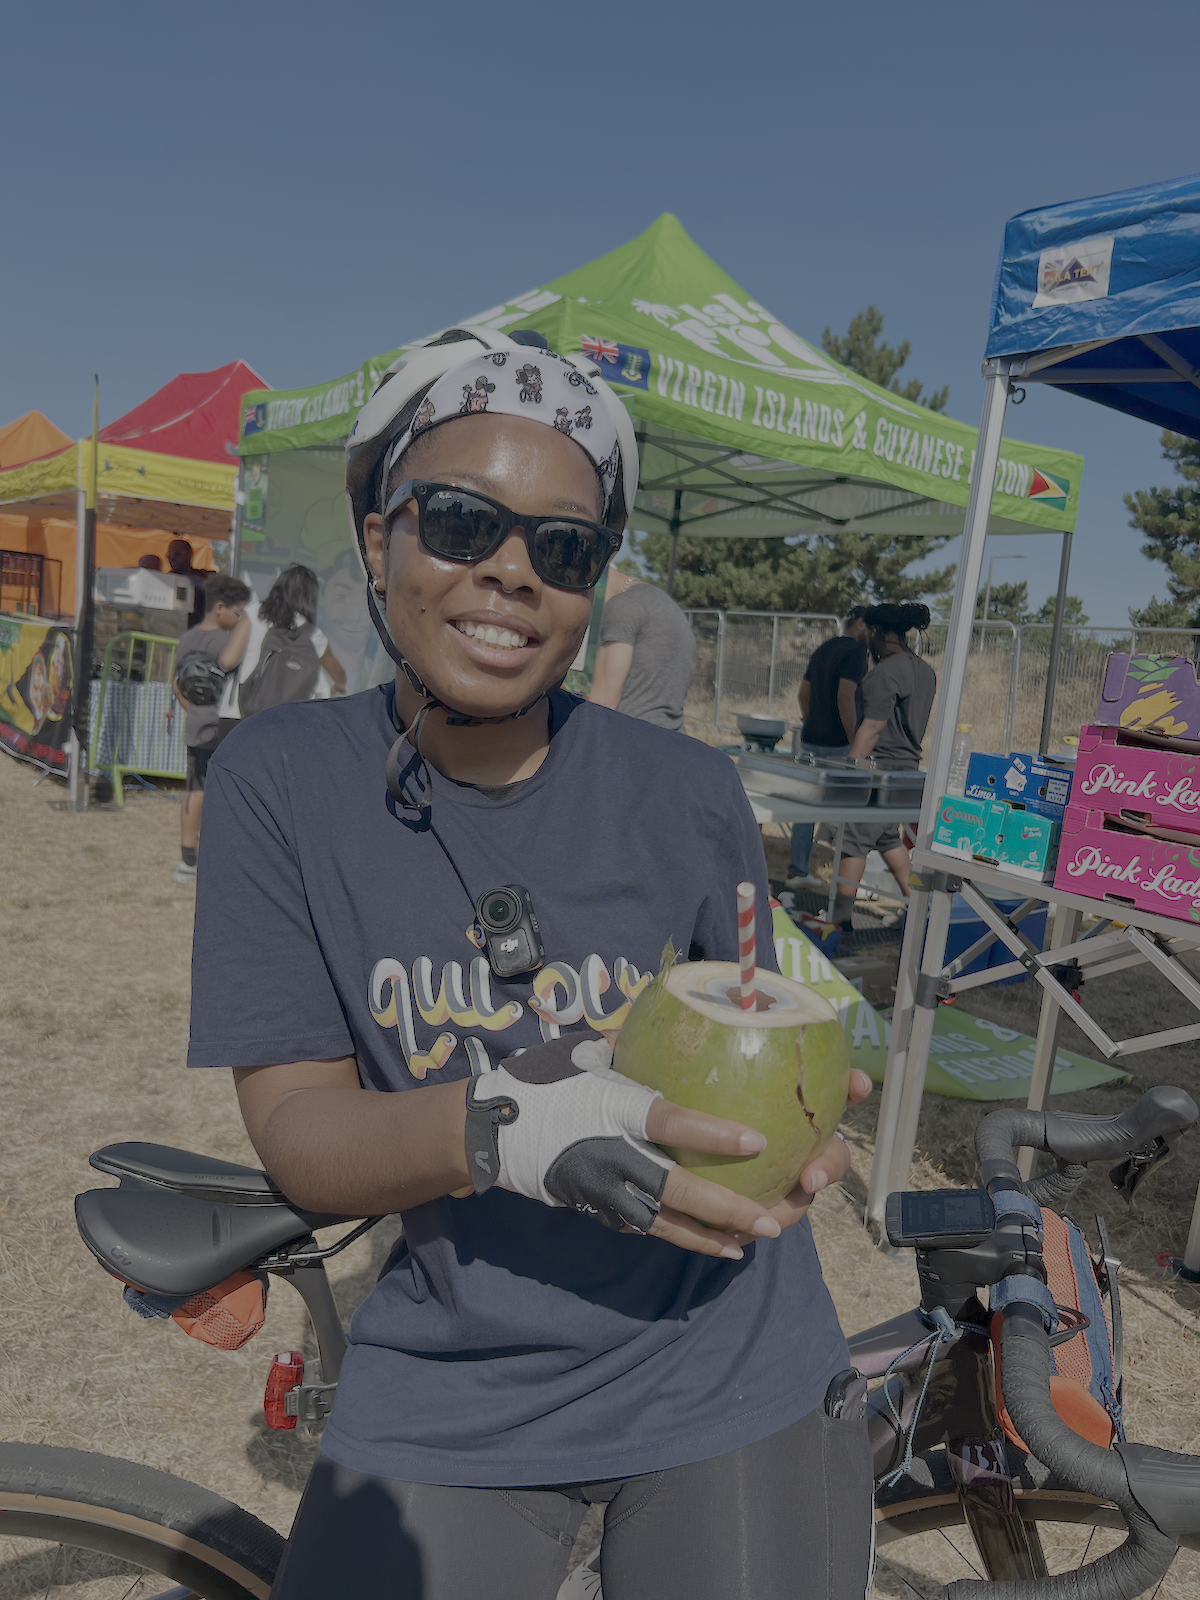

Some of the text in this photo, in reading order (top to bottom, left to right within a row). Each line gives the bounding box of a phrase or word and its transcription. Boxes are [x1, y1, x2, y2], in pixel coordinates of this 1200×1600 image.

[1044, 264, 1102, 285] GALA TENT
[268, 396, 310, 431] VIRGIN
[657, 353, 746, 422] VIRGIN
[751, 385, 845, 448] ISLANDS
[851, 410, 868, 450] &
[873, 416, 965, 482] GUYANESE
[965, 784, 997, 801] Limes
[1080, 762, 1200, 814] Pink La
[1066, 845, 1143, 884] Pink
[500, 938, 519, 952] dji
[974, 1018, 1024, 1043] &
